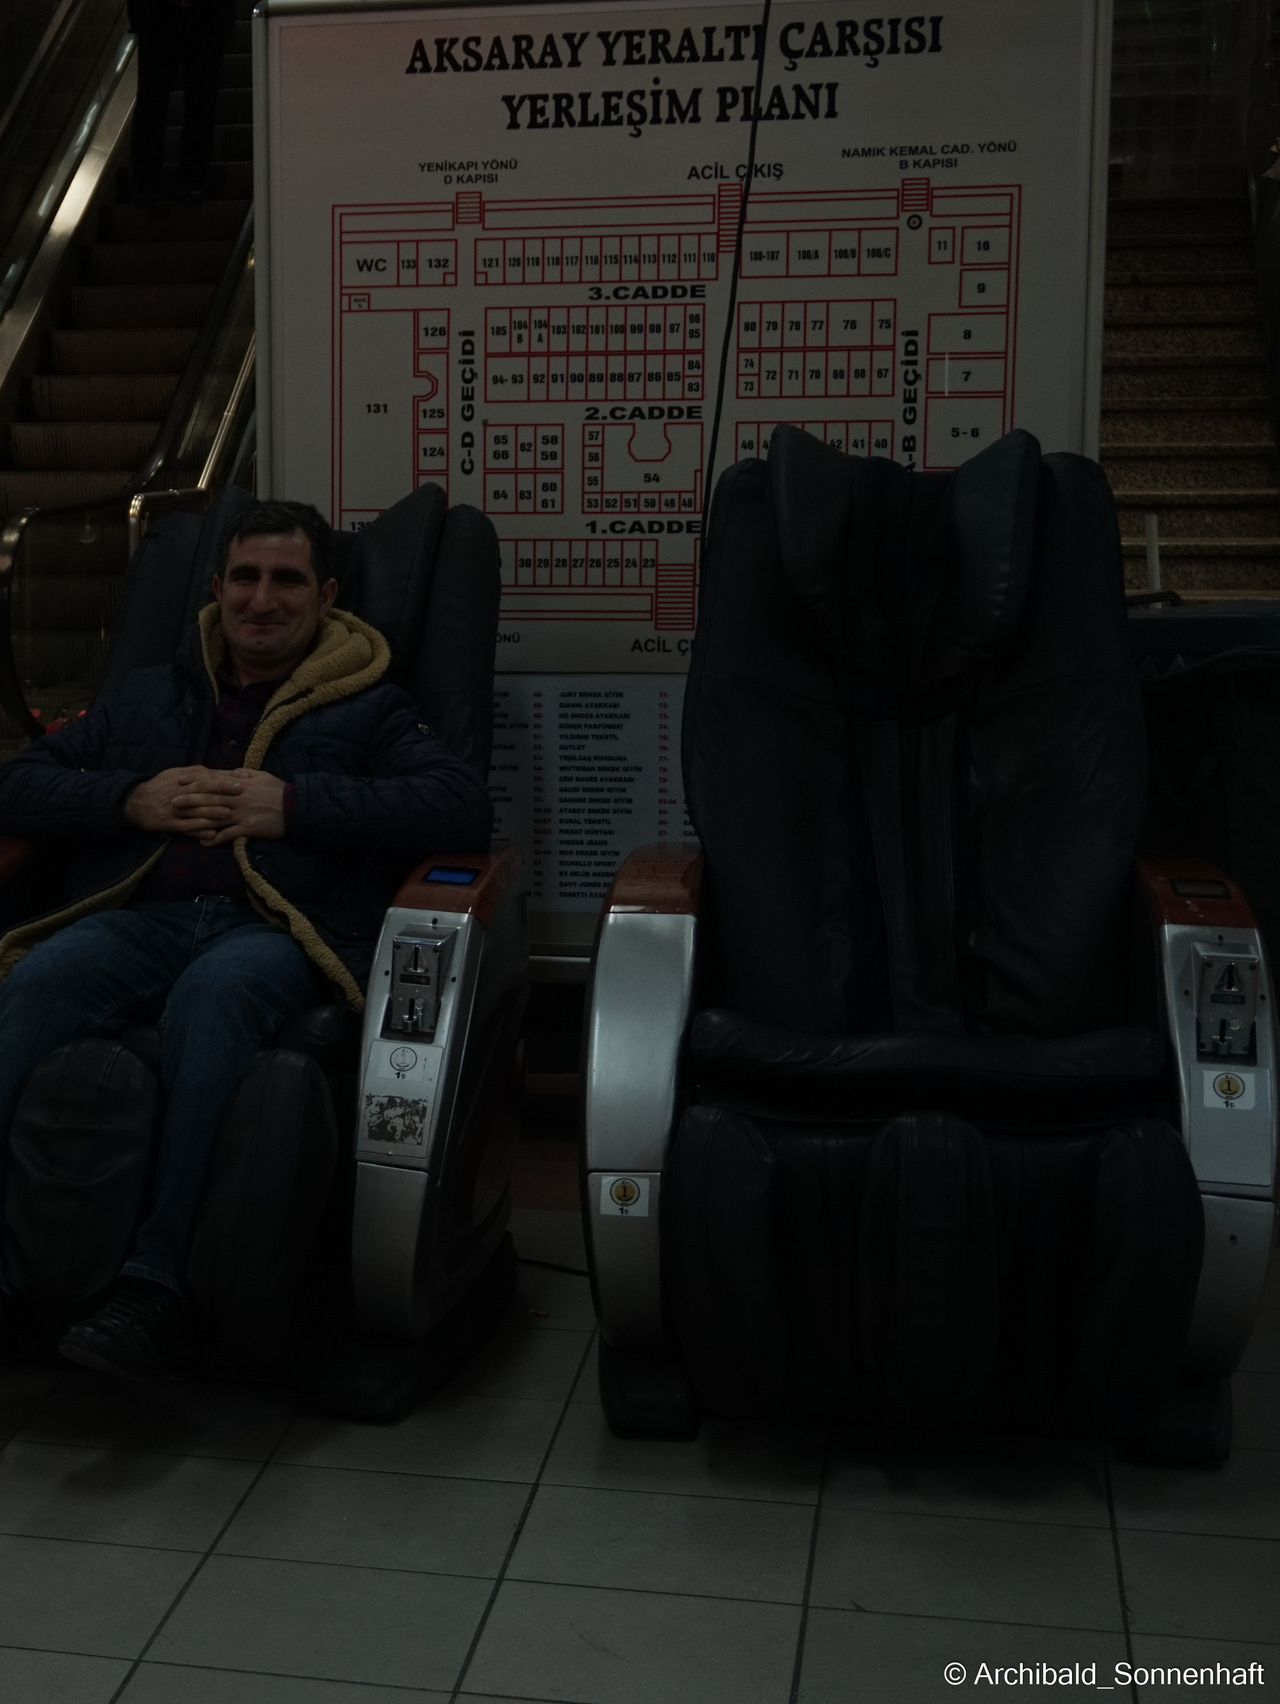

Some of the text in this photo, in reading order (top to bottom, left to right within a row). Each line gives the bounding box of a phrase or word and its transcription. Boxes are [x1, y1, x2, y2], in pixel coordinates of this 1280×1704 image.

[406, 16, 942, 73] AKSARAY YERALTI ÇARŞISI
[502, 77, 838, 137] YERLEŞİM PLANI
[841, 140, 1017, 158] NAMIK KEMAL CAD. YÖNÜ
[418, 159, 518, 172] YENİKAPI YÖNÜ
[899, 157, 958, 170] B KAPISI
[688, 162, 783, 181] ACİL ÇKIŞ
[443, 173, 498, 185] D KAPISI
[937, 240, 947, 251] 11
[976, 240, 990, 252] 10
[642, 253, 657, 264] 113
[661, 253, 677, 264] 112
[683, 253, 696, 263] 111
[702, 252, 716, 263] 110
[797, 249, 820, 260] 106/A
[834, 248, 857, 259] 106/B
[866, 247, 891, 259] 106/C
[357, 259, 386, 271] WC
[401, 259, 417, 270] 133
[427, 258, 449, 269] 132
[482, 257, 499, 268] 121
[508, 257, 521, 267] 120
[526, 256, 540, 267] 119
[546, 256, 561, 267] 118
[565, 255, 579, 266] 117
[584, 255, 599, 266] 116
[603, 254, 619, 265] 115
[623, 254, 639, 265] 114
[977, 283, 986, 294] 9
[533, 319, 548, 329] 104
[688, 313, 701, 324] 96
[878, 318, 892, 330] 75
[512, 320, 528, 330] 104
[551, 324, 567, 335] 103
[571, 324, 587, 335] 102
[589, 324, 605, 335] 101
[609, 324, 625, 335] 100
[630, 323, 644, 334] 99
[648, 323, 662, 334] 98
[669, 323, 681, 334] 97
[743, 321, 757, 332] 80
[765, 320, 778, 331] 79
[788, 320, 801, 331] 78
[811, 320, 824, 331] 77
[843, 319, 857, 330] 76
[423, 326, 447, 337] 126
[490, 325, 507, 336] 105
[688, 328, 701, 339] 95
[963, 329, 972, 340] 8
[516, 333, 523, 344] B
[537, 333, 544, 343] A
[687, 360, 701, 370] 84
[744, 358, 755, 369] 74
[511, 374, 524, 384] 93
[532, 373, 546, 384] 92
[551, 373, 564, 384] 91
[569, 373, 584, 383] 90
[588, 372, 604, 383] 89
[609, 372, 624, 383] 88
[627, 372, 642, 383] 87
[647, 372, 662, 382] 86
[666, 371, 681, 382] 85
[765, 370, 777, 381] 72
[787, 369, 799, 380] 71
[809, 369, 821, 380] 70
[832, 369, 845, 380] 69
[854, 368, 866, 379] 68
[876, 368, 889, 379] 67
[901, 331, 921, 424] GEÇİDİ
[962, 371, 972, 382] 7
[492, 374, 508, 385] 94-
[687, 382, 700, 393] 83
[743, 381, 754, 392] 73
[366, 403, 388, 414] 131
[459, 331, 477, 475] C-D GEÇİDİ
[422, 408, 445, 419] 125
[585, 406, 701, 420] 2.CADDE
[493, 434, 508, 445] 65
[541, 435, 559, 445] 58
[588, 430, 600, 441] 57
[520, 442, 533, 452] 62
[740, 440, 754, 450] 46
[830, 439, 843, 450] 42
[852, 438, 865, 449] 41
[874, 438, 888, 449] 40
[422, 447, 445, 457] 124
[492, 449, 509, 460] 66
[540, 450, 558, 461] 59
[588, 452, 600, 462] 56
[587, 476, 599, 487] 55
[643, 473, 660, 483] 54
[541, 482, 557, 492] 60
[493, 489, 508, 500] 64
[519, 490, 532, 500] 63
[541, 498, 556, 509] 61
[586, 498, 599, 509] 53
[604, 498, 618, 509] 52
[624, 498, 637, 508] 51
[644, 498, 656, 508] 50
[663, 498, 676, 508] 49
[681, 498, 693, 508] 48
[586, 521, 701, 534] 1.CADDE
[518, 558, 532, 568] 30
[537, 558, 550, 568] 29
[554, 558, 568, 568] 28
[571, 558, 585, 568] 27
[589, 558, 602, 568] 26
[606, 558, 620, 568] 25
[624, 558, 638, 568] 24
[642, 558, 656, 568] 23
[631, 637, 671, 652] ACİL
